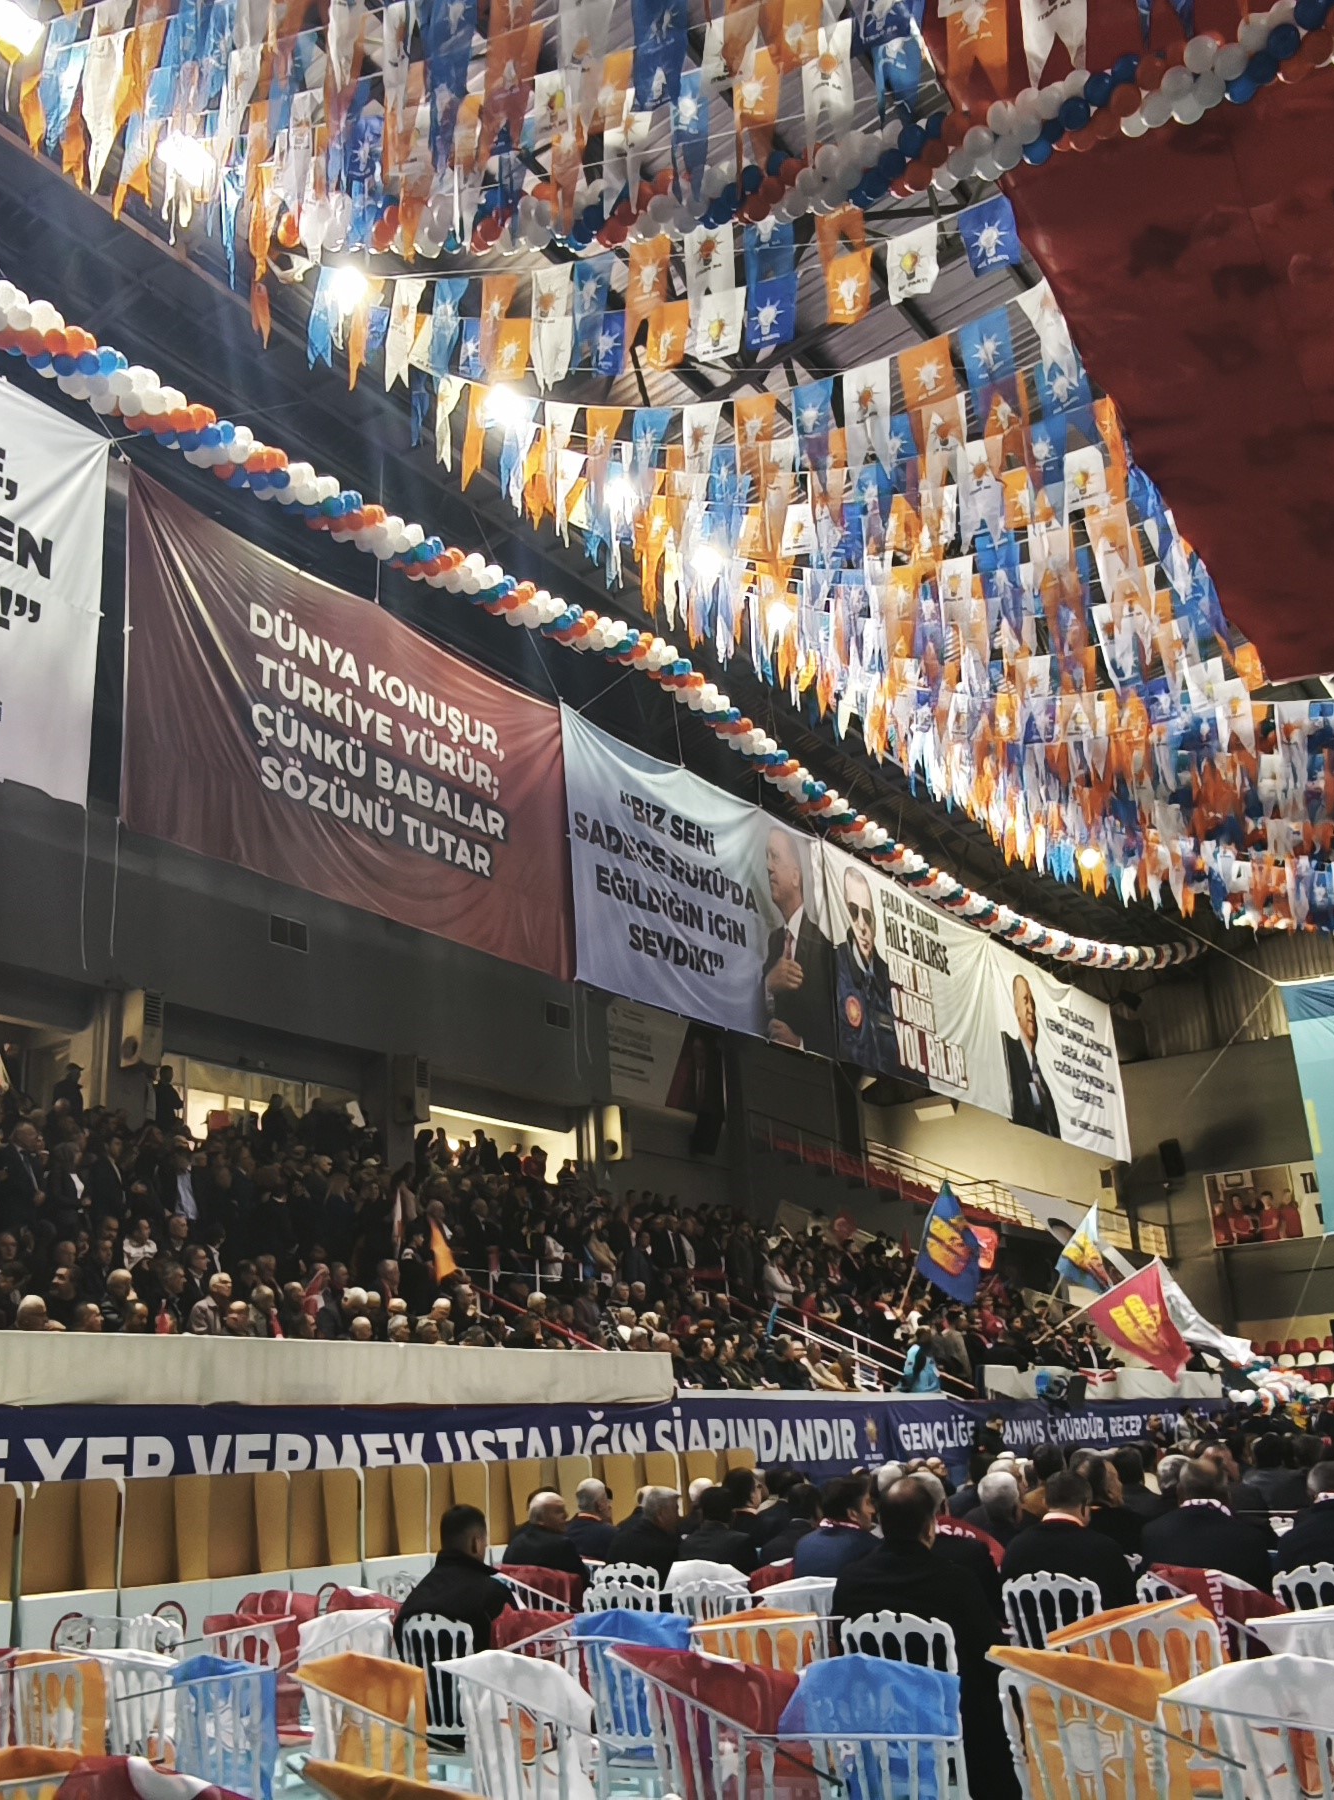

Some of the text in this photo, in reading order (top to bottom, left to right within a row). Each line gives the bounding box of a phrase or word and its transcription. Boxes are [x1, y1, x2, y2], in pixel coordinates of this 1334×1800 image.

[249, 602, 505, 762] DÜNYA KONUŞUR,
[255, 654, 500, 801] TÜRKİYE YÜRÜR;
[252, 703, 505, 841] ÇÜNKÜ BABALAR
[260, 755, 491, 877] SÖZÜNÜ TUTAR
[670, 815, 717, 857] SENİ
[1109, 1414, 1142, 1438] RECEP
